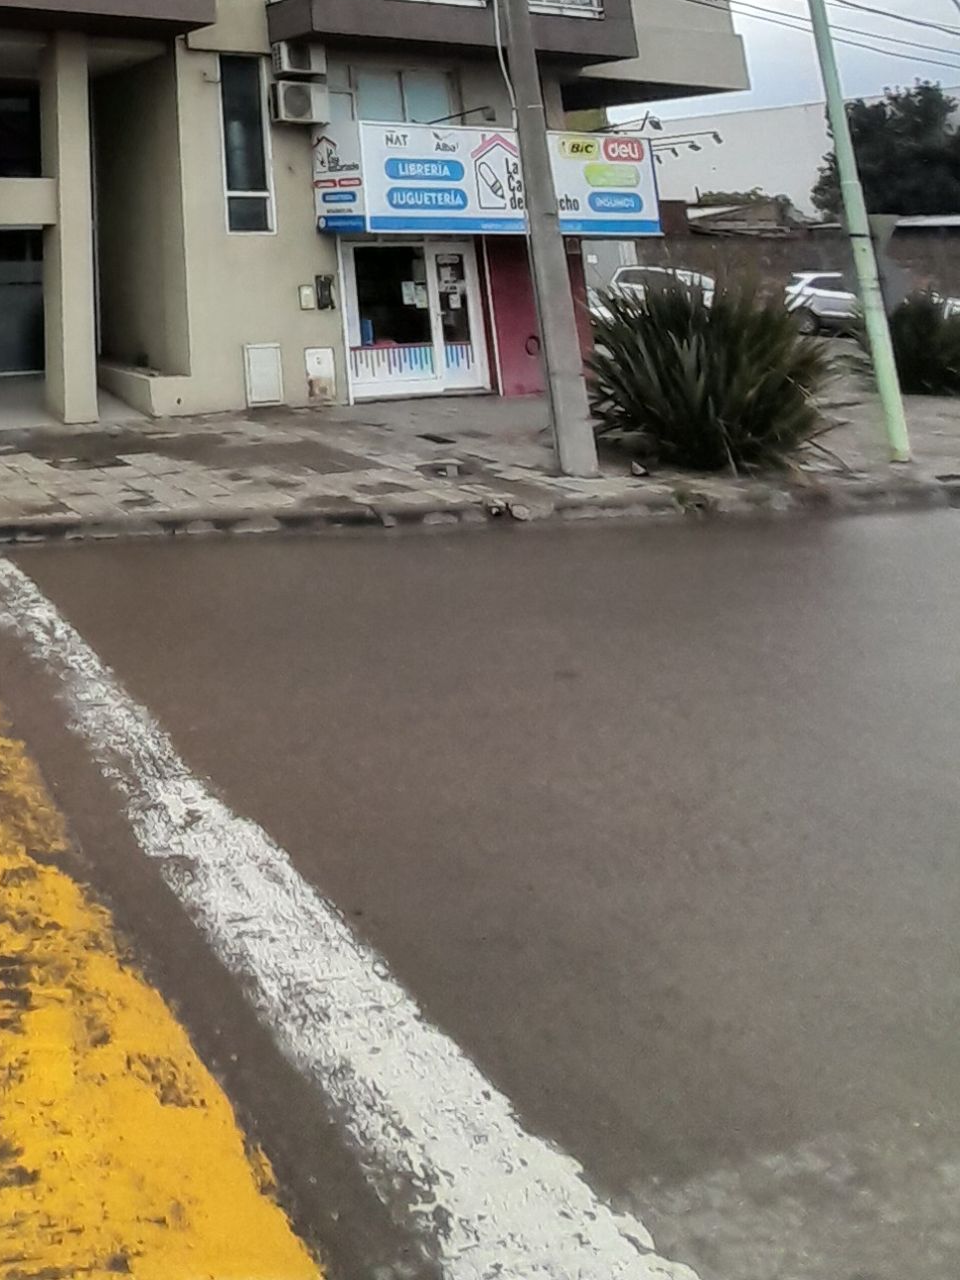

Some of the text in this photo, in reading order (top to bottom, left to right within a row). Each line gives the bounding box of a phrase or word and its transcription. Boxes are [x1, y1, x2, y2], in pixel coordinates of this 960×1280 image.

[398, 162, 451, 176] LIBRERÍA
[505, 157, 519, 175] La
[392, 191, 464, 206] JUGUETERÍA
